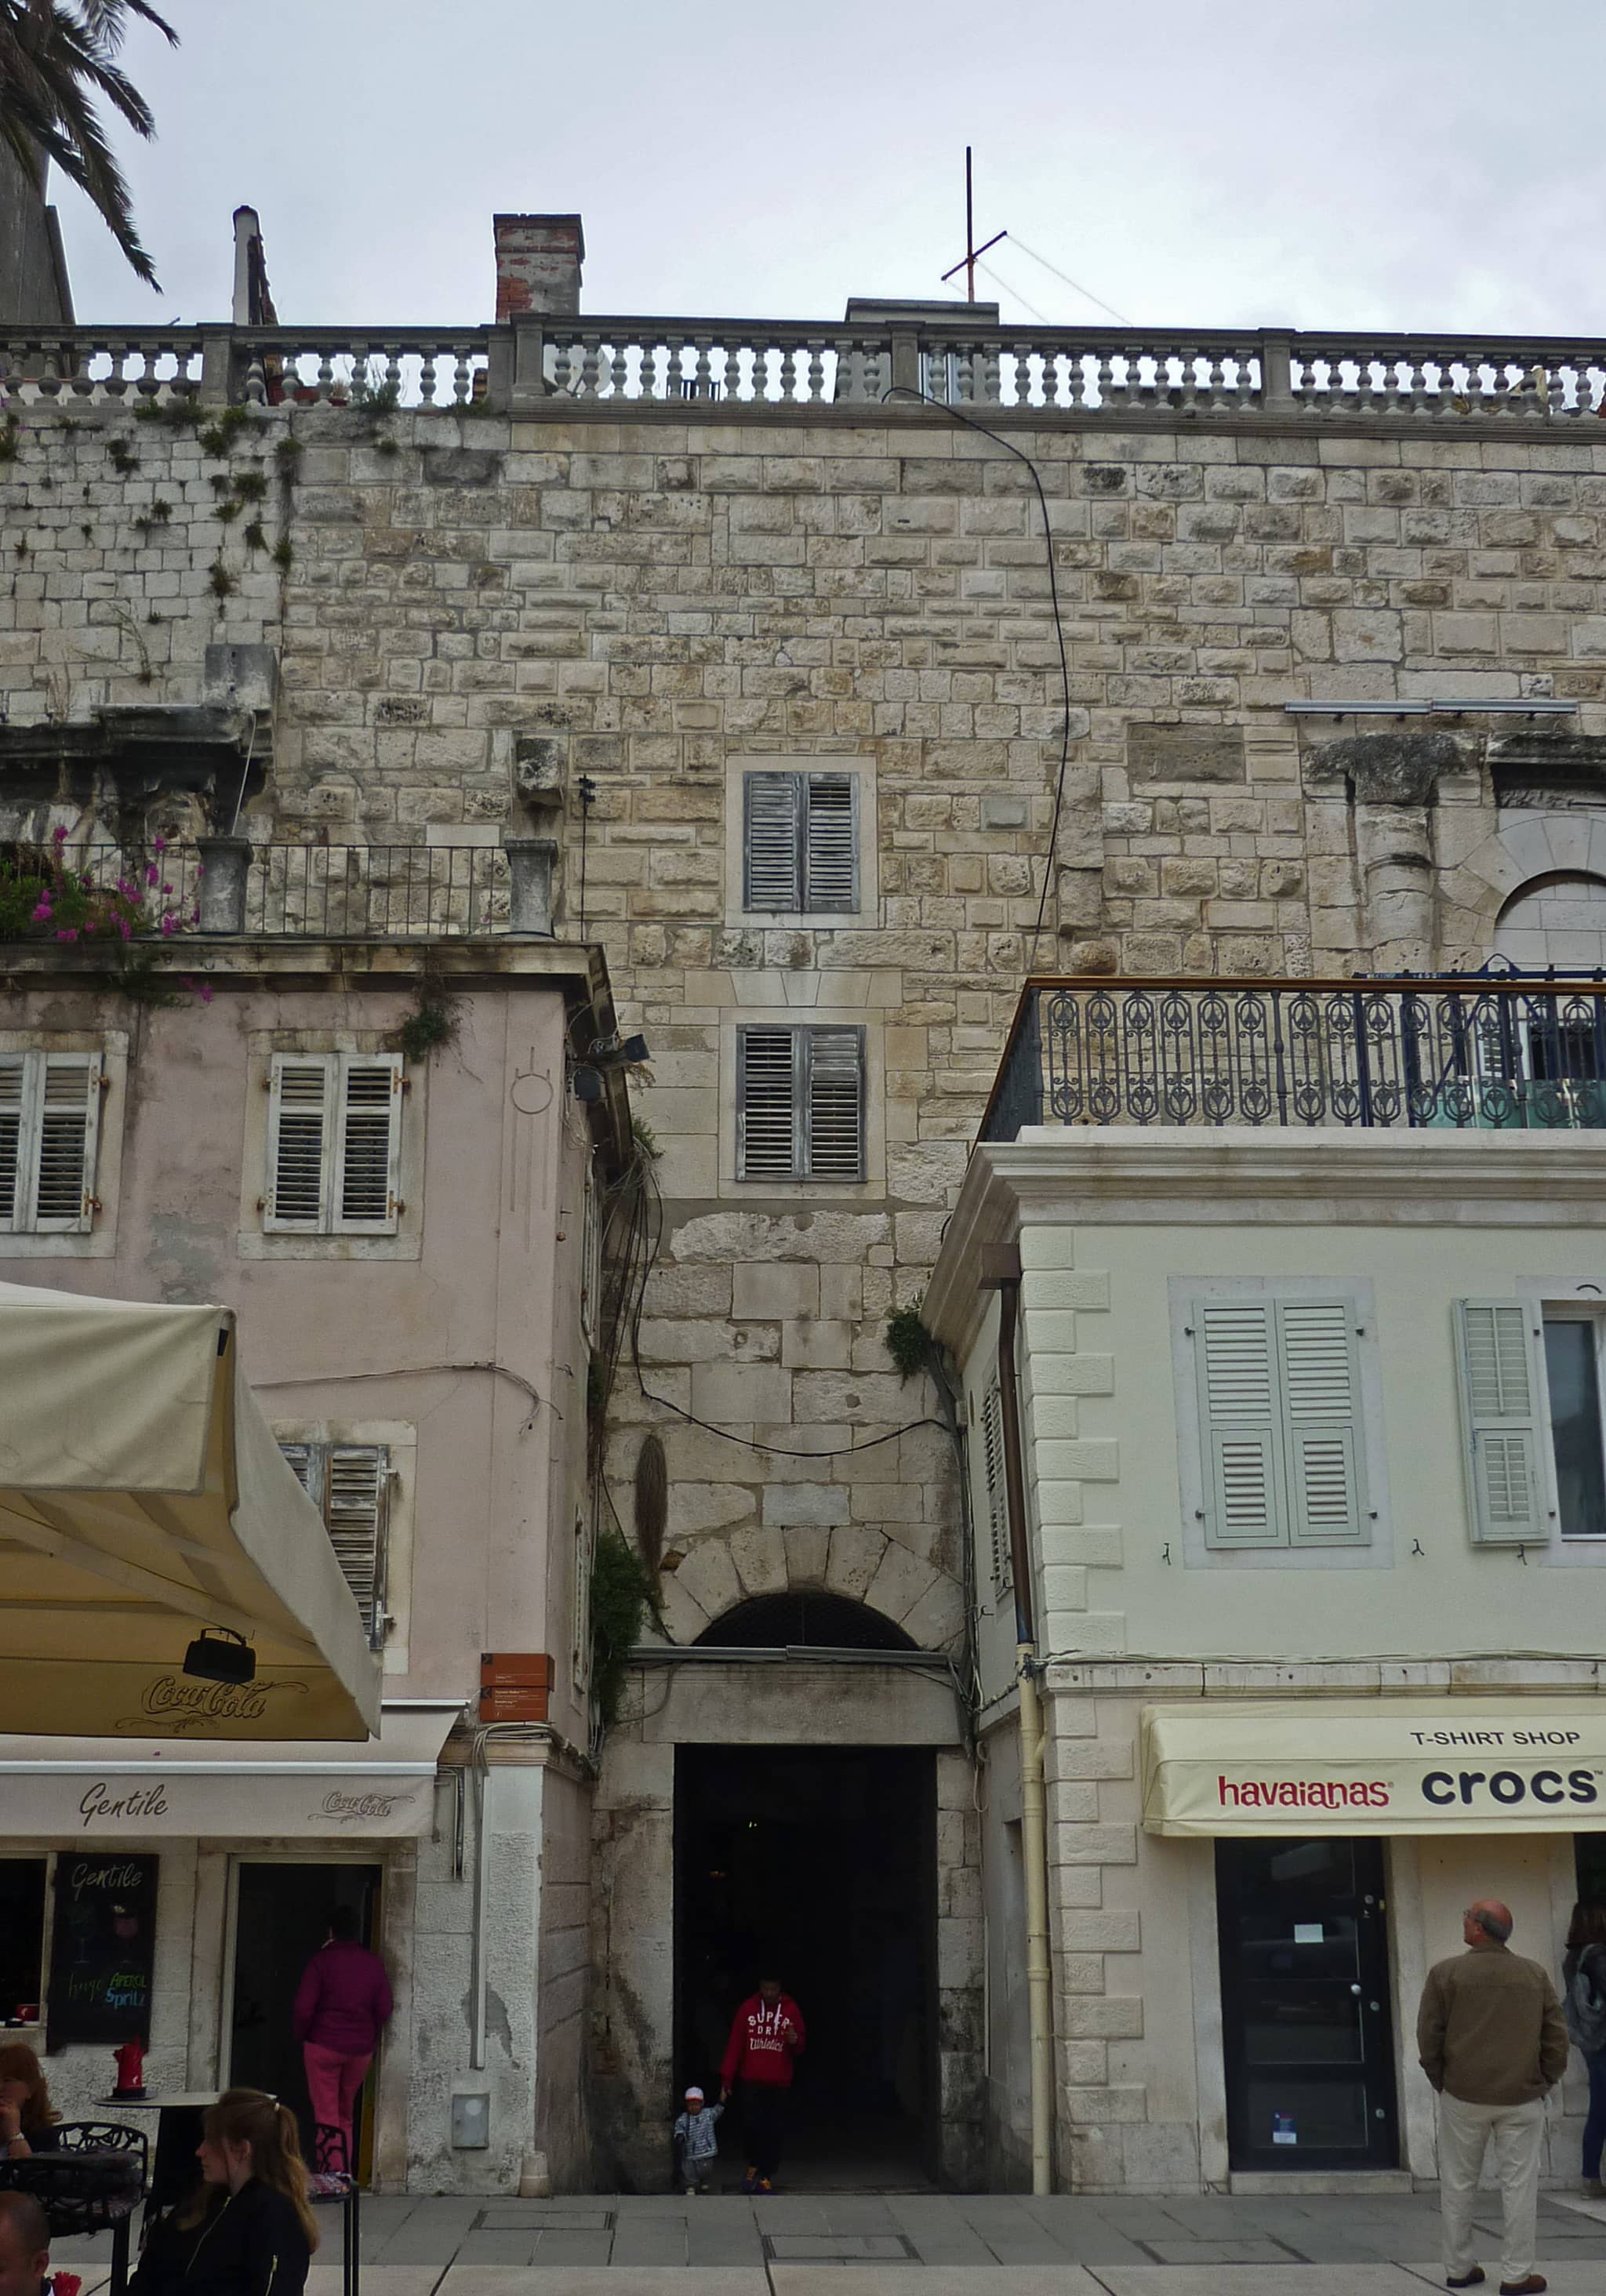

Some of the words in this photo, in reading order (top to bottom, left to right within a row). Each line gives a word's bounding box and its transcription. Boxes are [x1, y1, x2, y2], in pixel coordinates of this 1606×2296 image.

[1410, 1731, 1505, 1746] T-SHIRT
[1513, 1731, 1581, 1746] SHOP
[78, 1782, 168, 1826] Gentile
[1218, 1775, 1390, 1809] havaianas
[1422, 1770, 1598, 1805] crocs
[71, 1863, 144, 1902] Gentile
